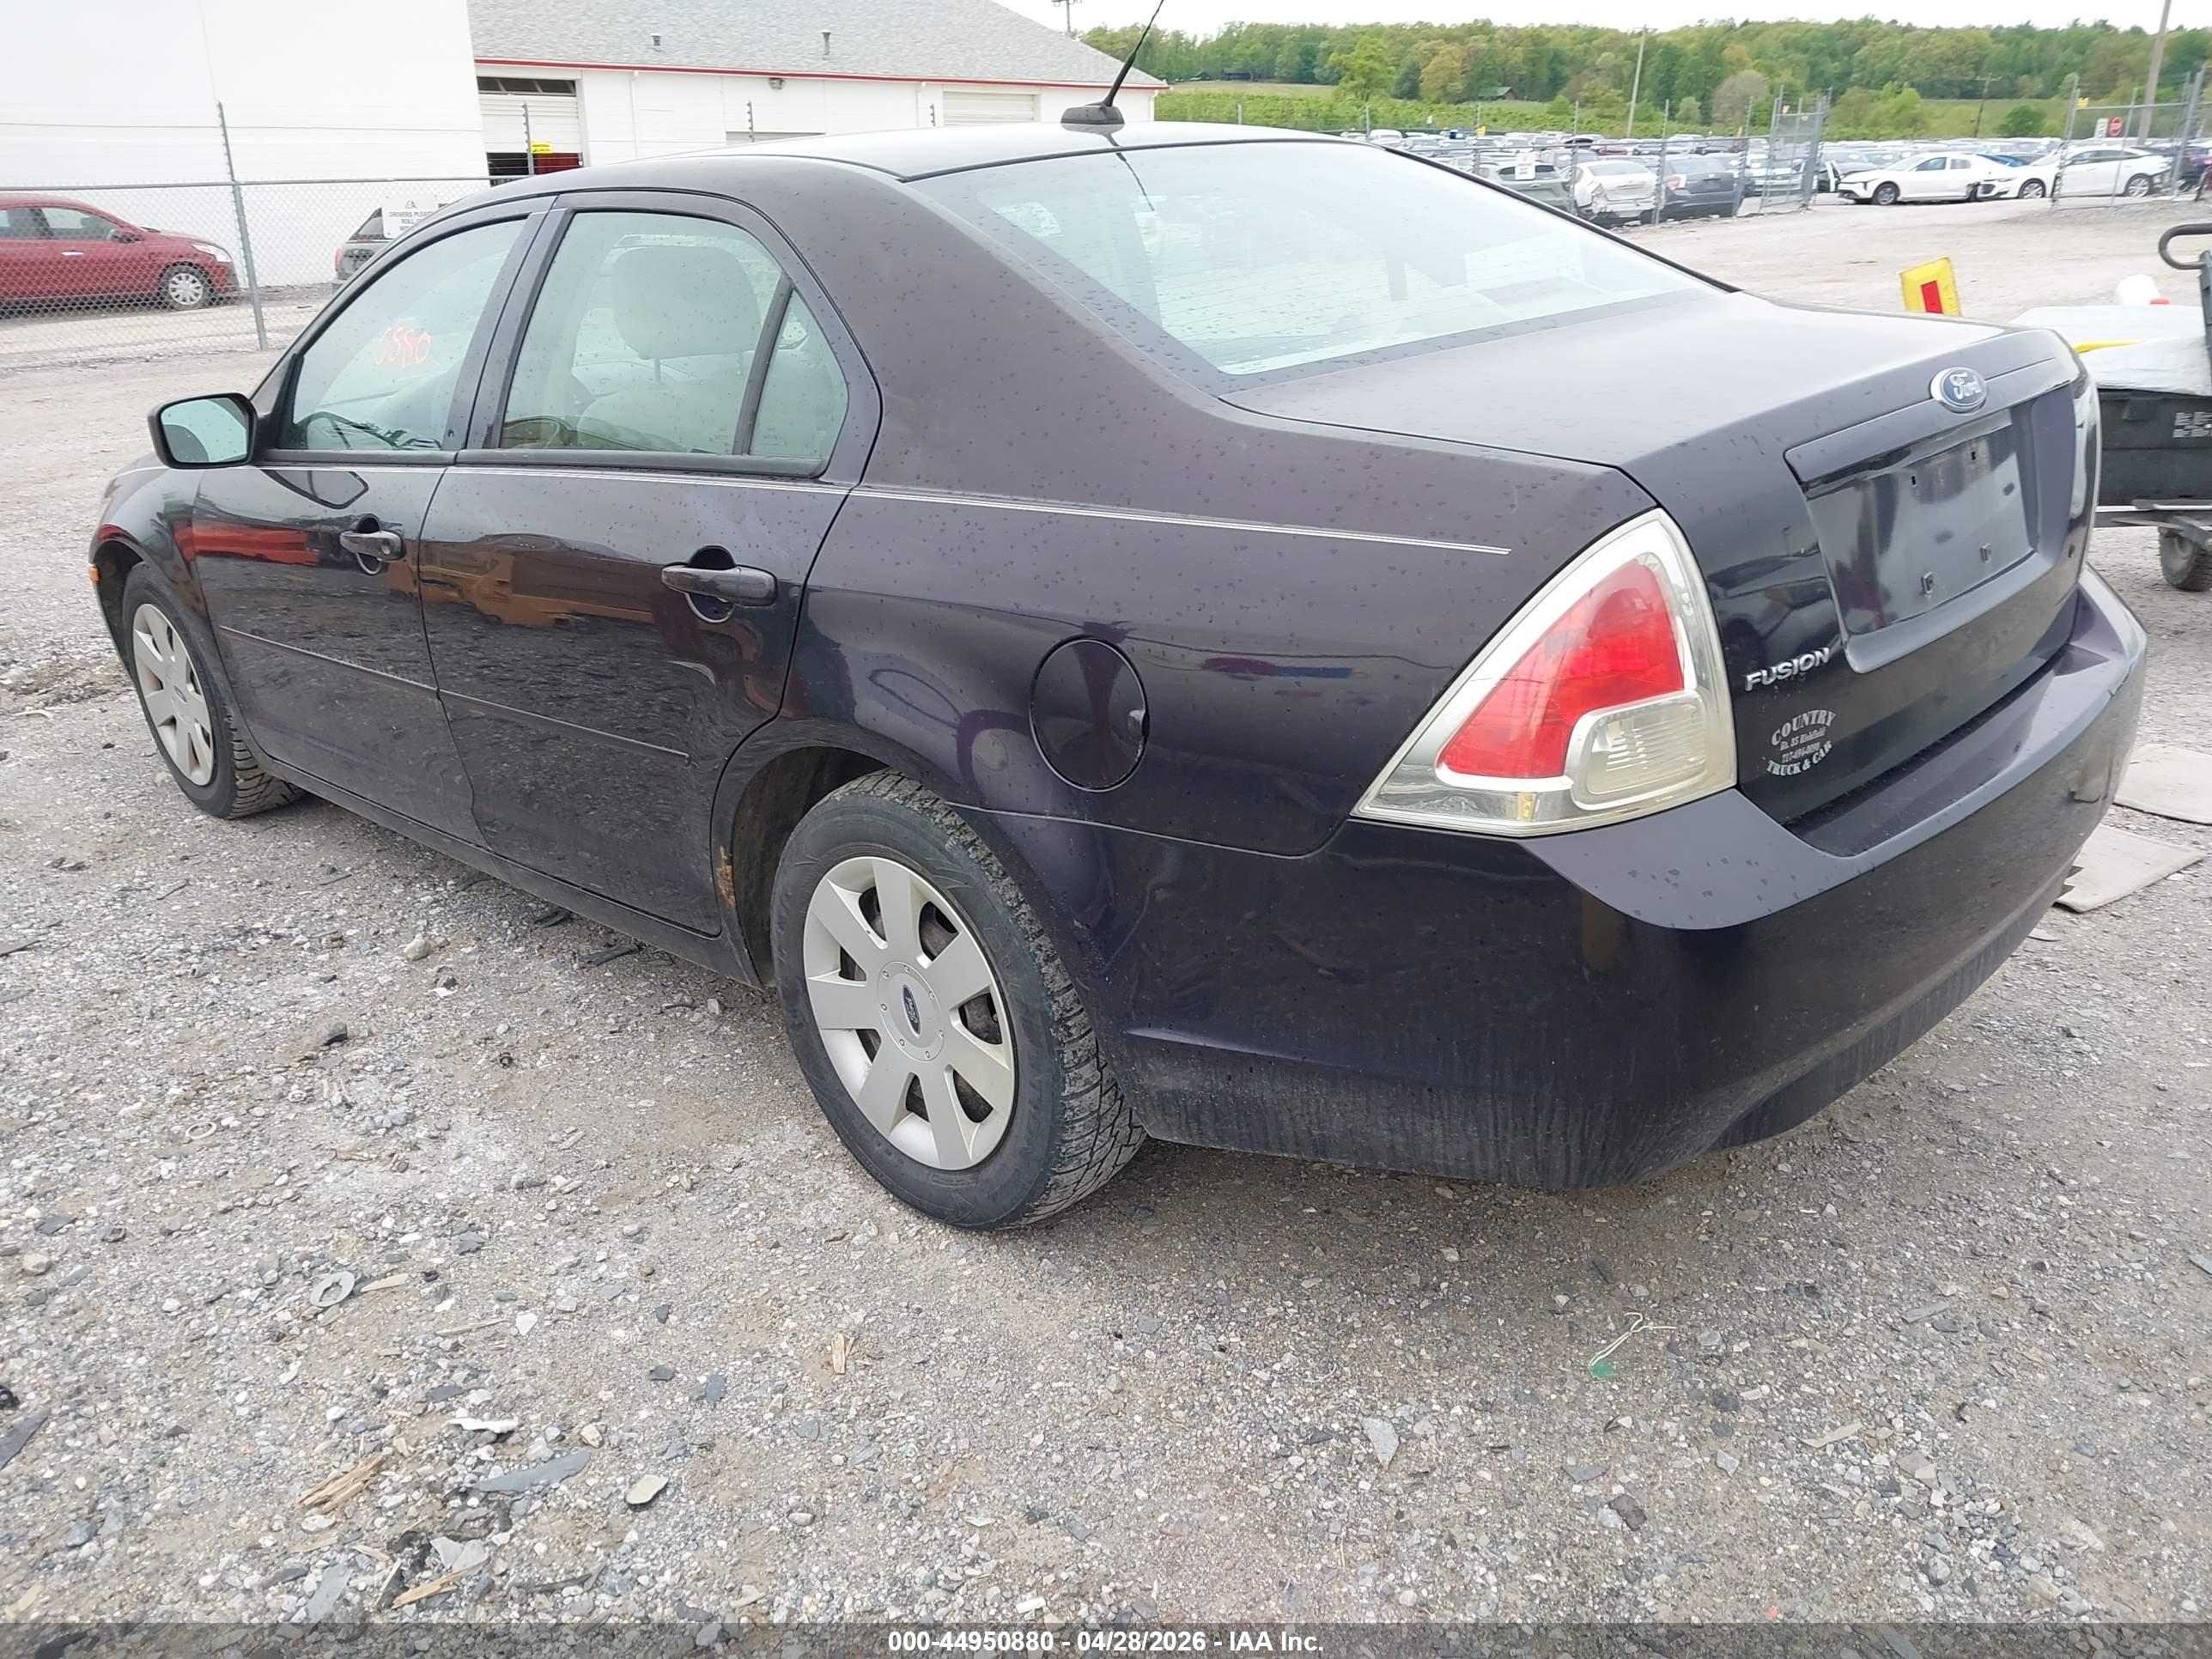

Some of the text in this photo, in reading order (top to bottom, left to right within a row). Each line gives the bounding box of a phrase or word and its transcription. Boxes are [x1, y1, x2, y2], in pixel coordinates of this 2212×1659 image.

[1949, 371, 1982, 400] Ford
[1744, 647, 1830, 691] FUSION
[1771, 709, 1837, 746] COUNTRY
[1766, 759, 1802, 776] TRUCK
[1802, 758, 1812, 771] &
